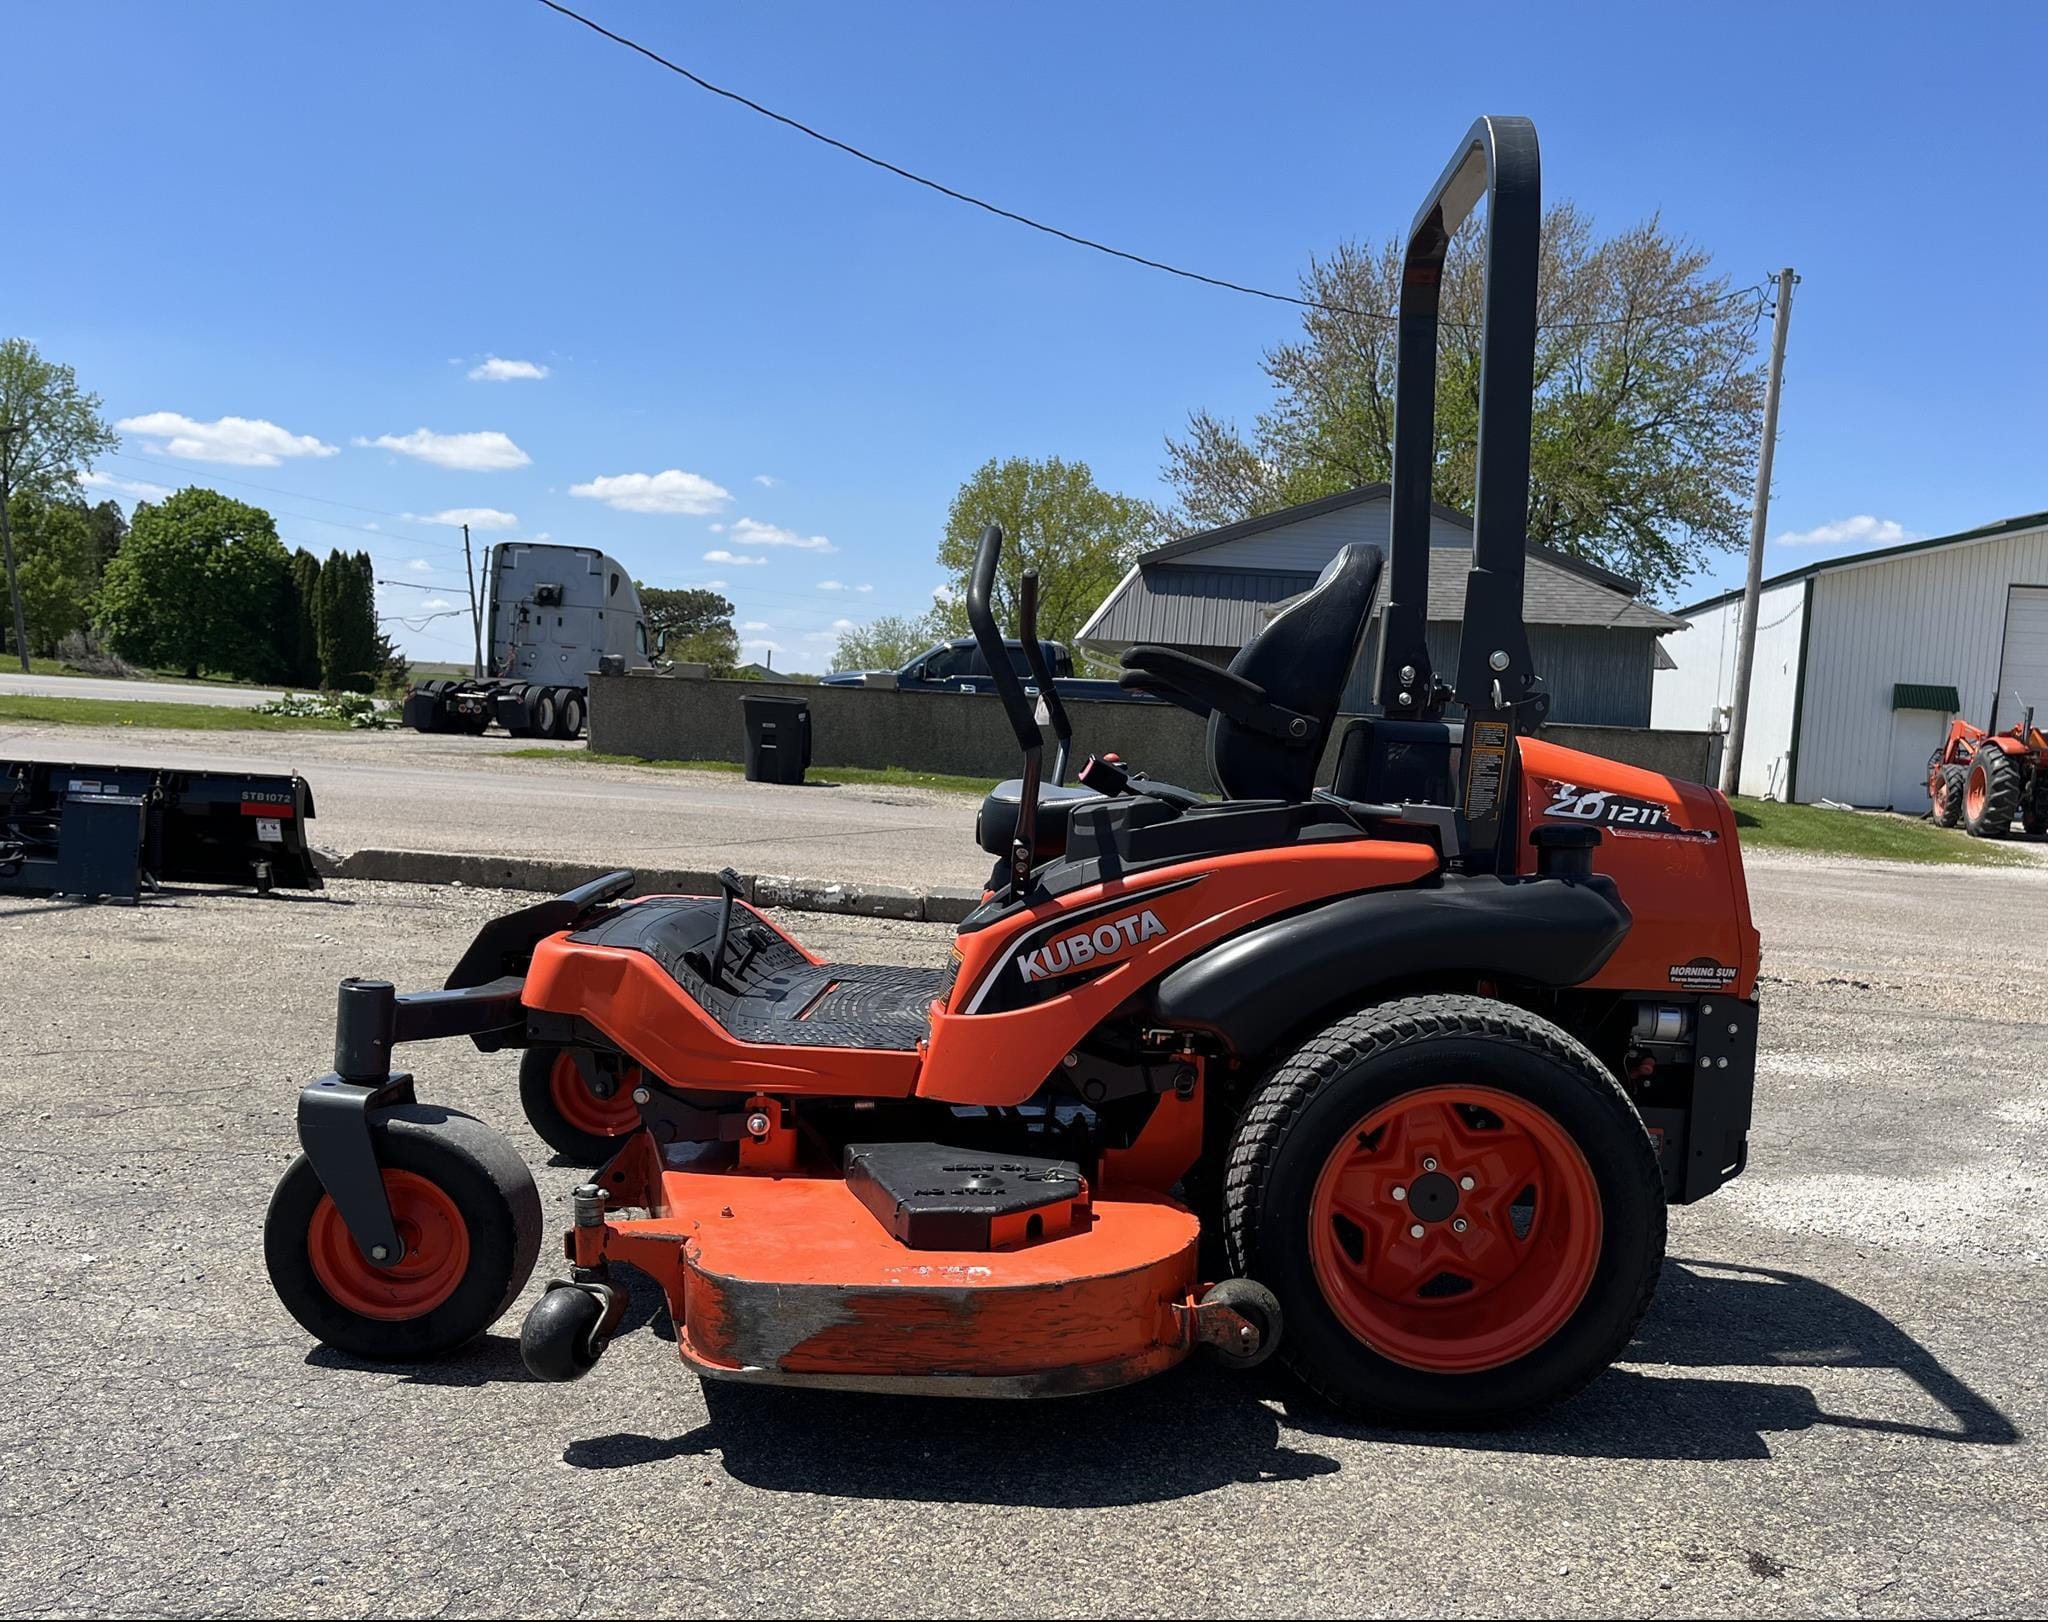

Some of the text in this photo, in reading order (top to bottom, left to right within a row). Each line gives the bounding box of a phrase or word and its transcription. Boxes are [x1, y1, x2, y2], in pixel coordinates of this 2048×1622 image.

[241, 791, 291, 803] STB1072
[1607, 805, 1662, 825] 1211
[1017, 909, 1168, 983] KUBOTA
[1670, 966, 1737, 977] MORNING SUN
